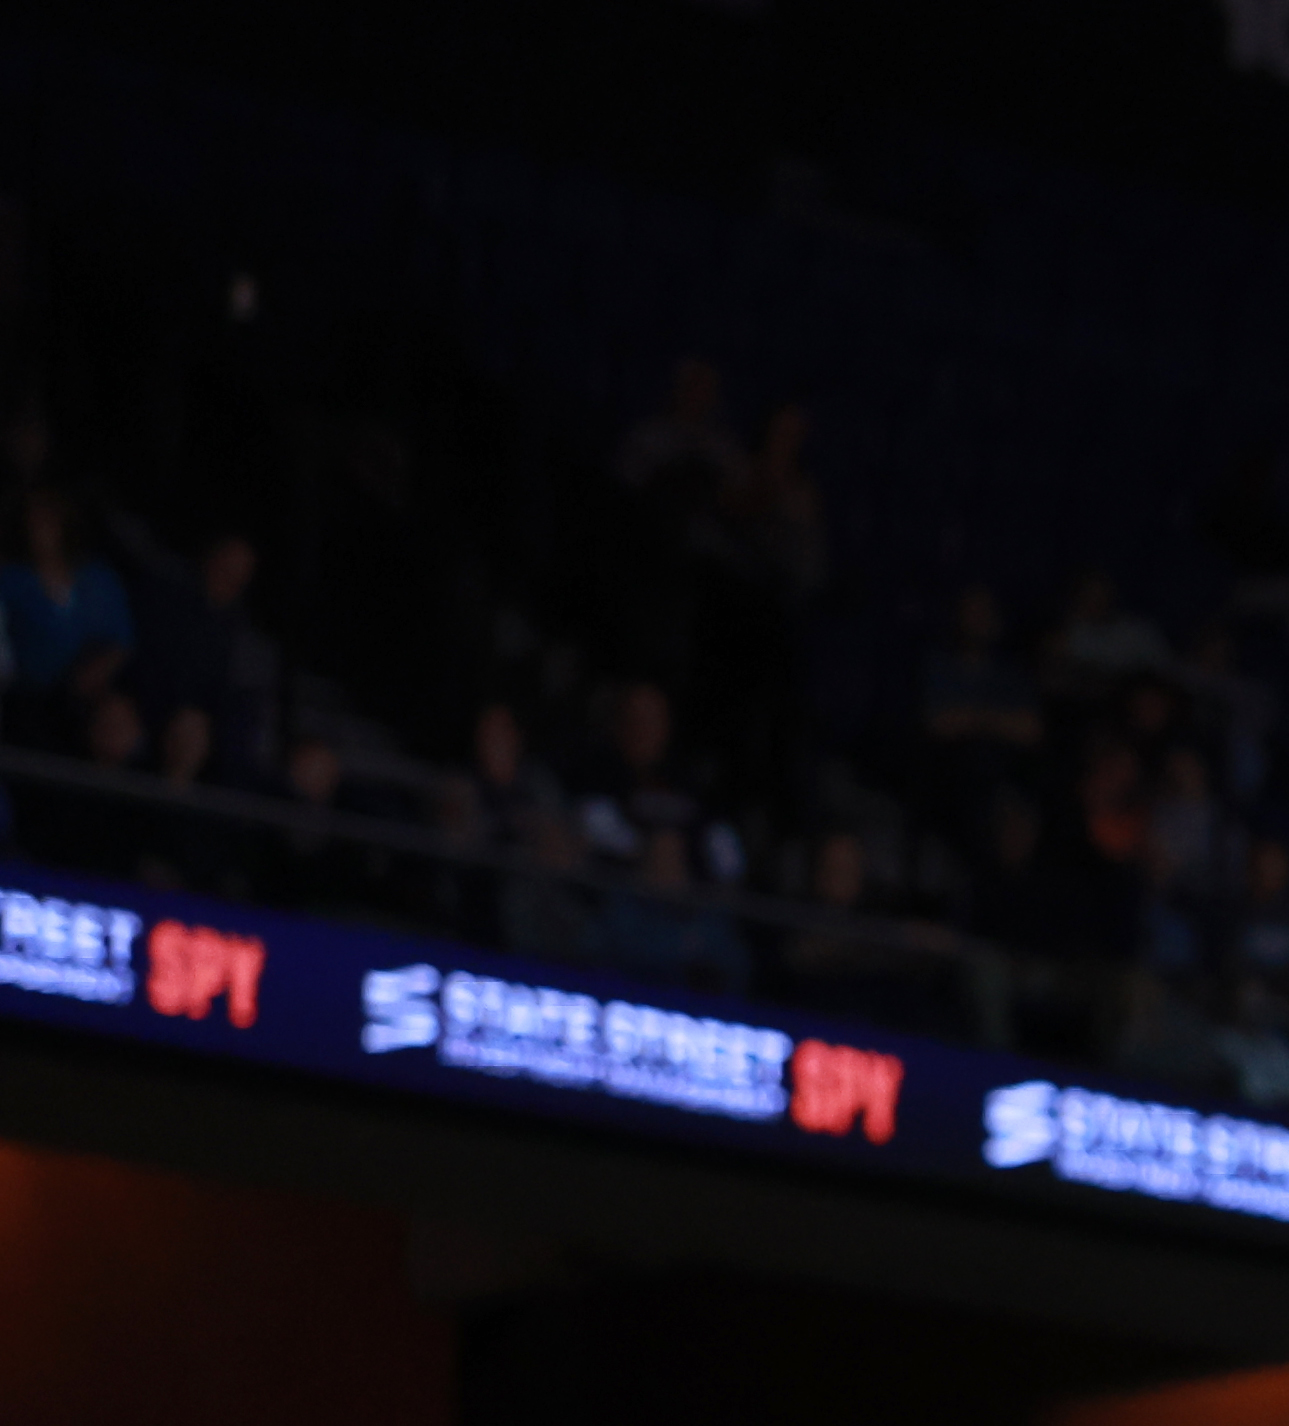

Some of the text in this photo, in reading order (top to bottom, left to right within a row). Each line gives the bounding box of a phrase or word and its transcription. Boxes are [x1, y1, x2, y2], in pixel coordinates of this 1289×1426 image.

[0, 888, 143, 966] REET
[147, 919, 267, 1029] SPY
[442, 970, 600, 1050] STATE
[602, 1000, 794, 1088] STREET
[790, 1037, 904, 1144] SPY
